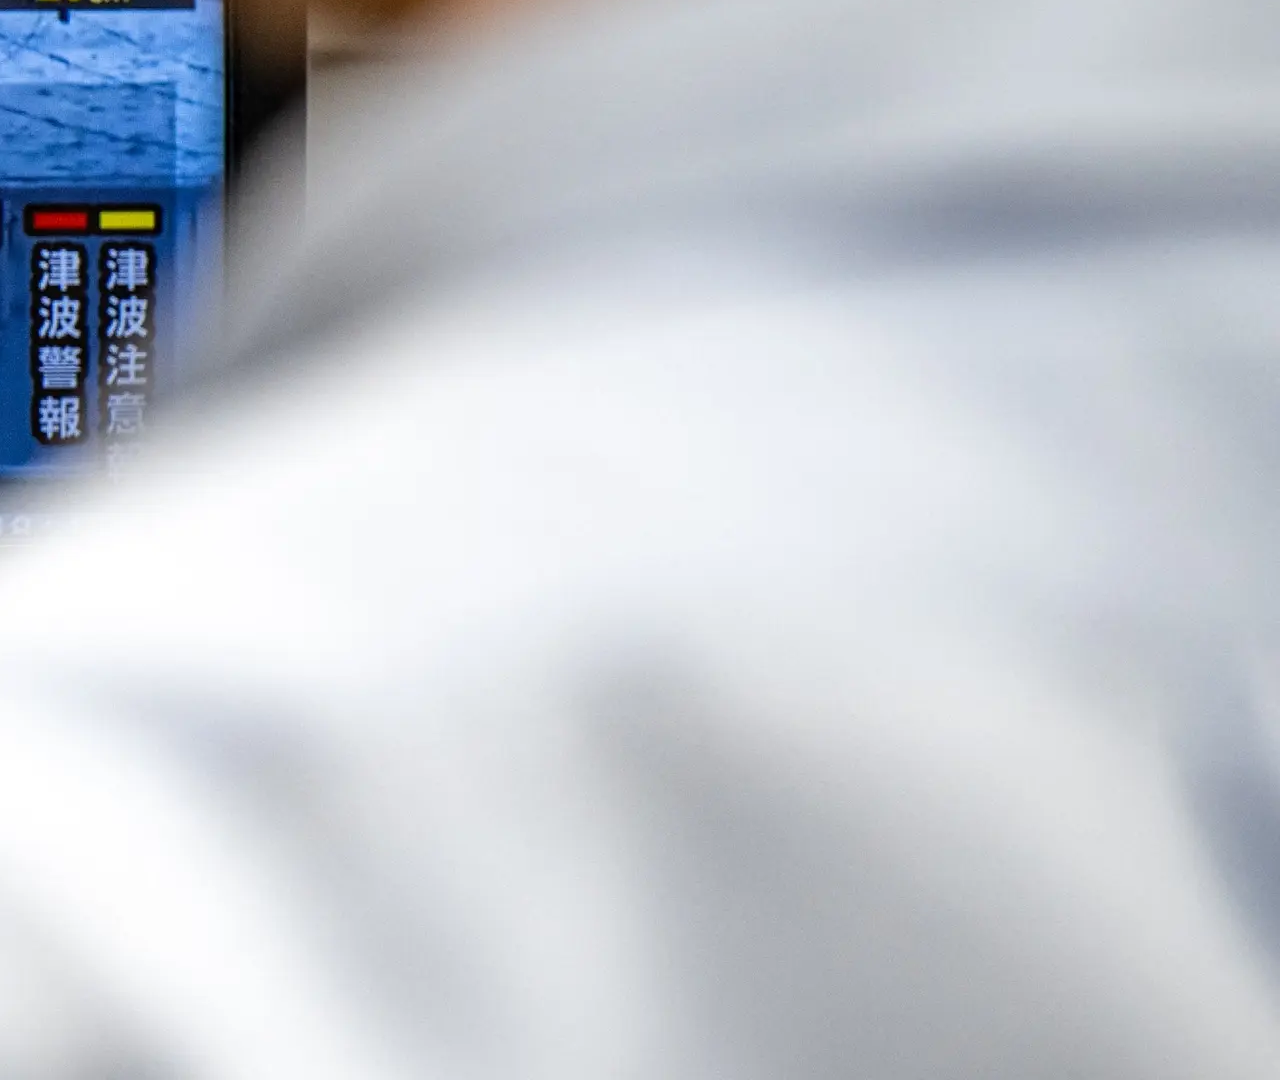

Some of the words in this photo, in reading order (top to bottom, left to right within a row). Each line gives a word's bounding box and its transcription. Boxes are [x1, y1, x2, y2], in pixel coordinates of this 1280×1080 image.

[38, 248, 82, 441] 津波警報
[105, 248, 150, 480] 津波注意
